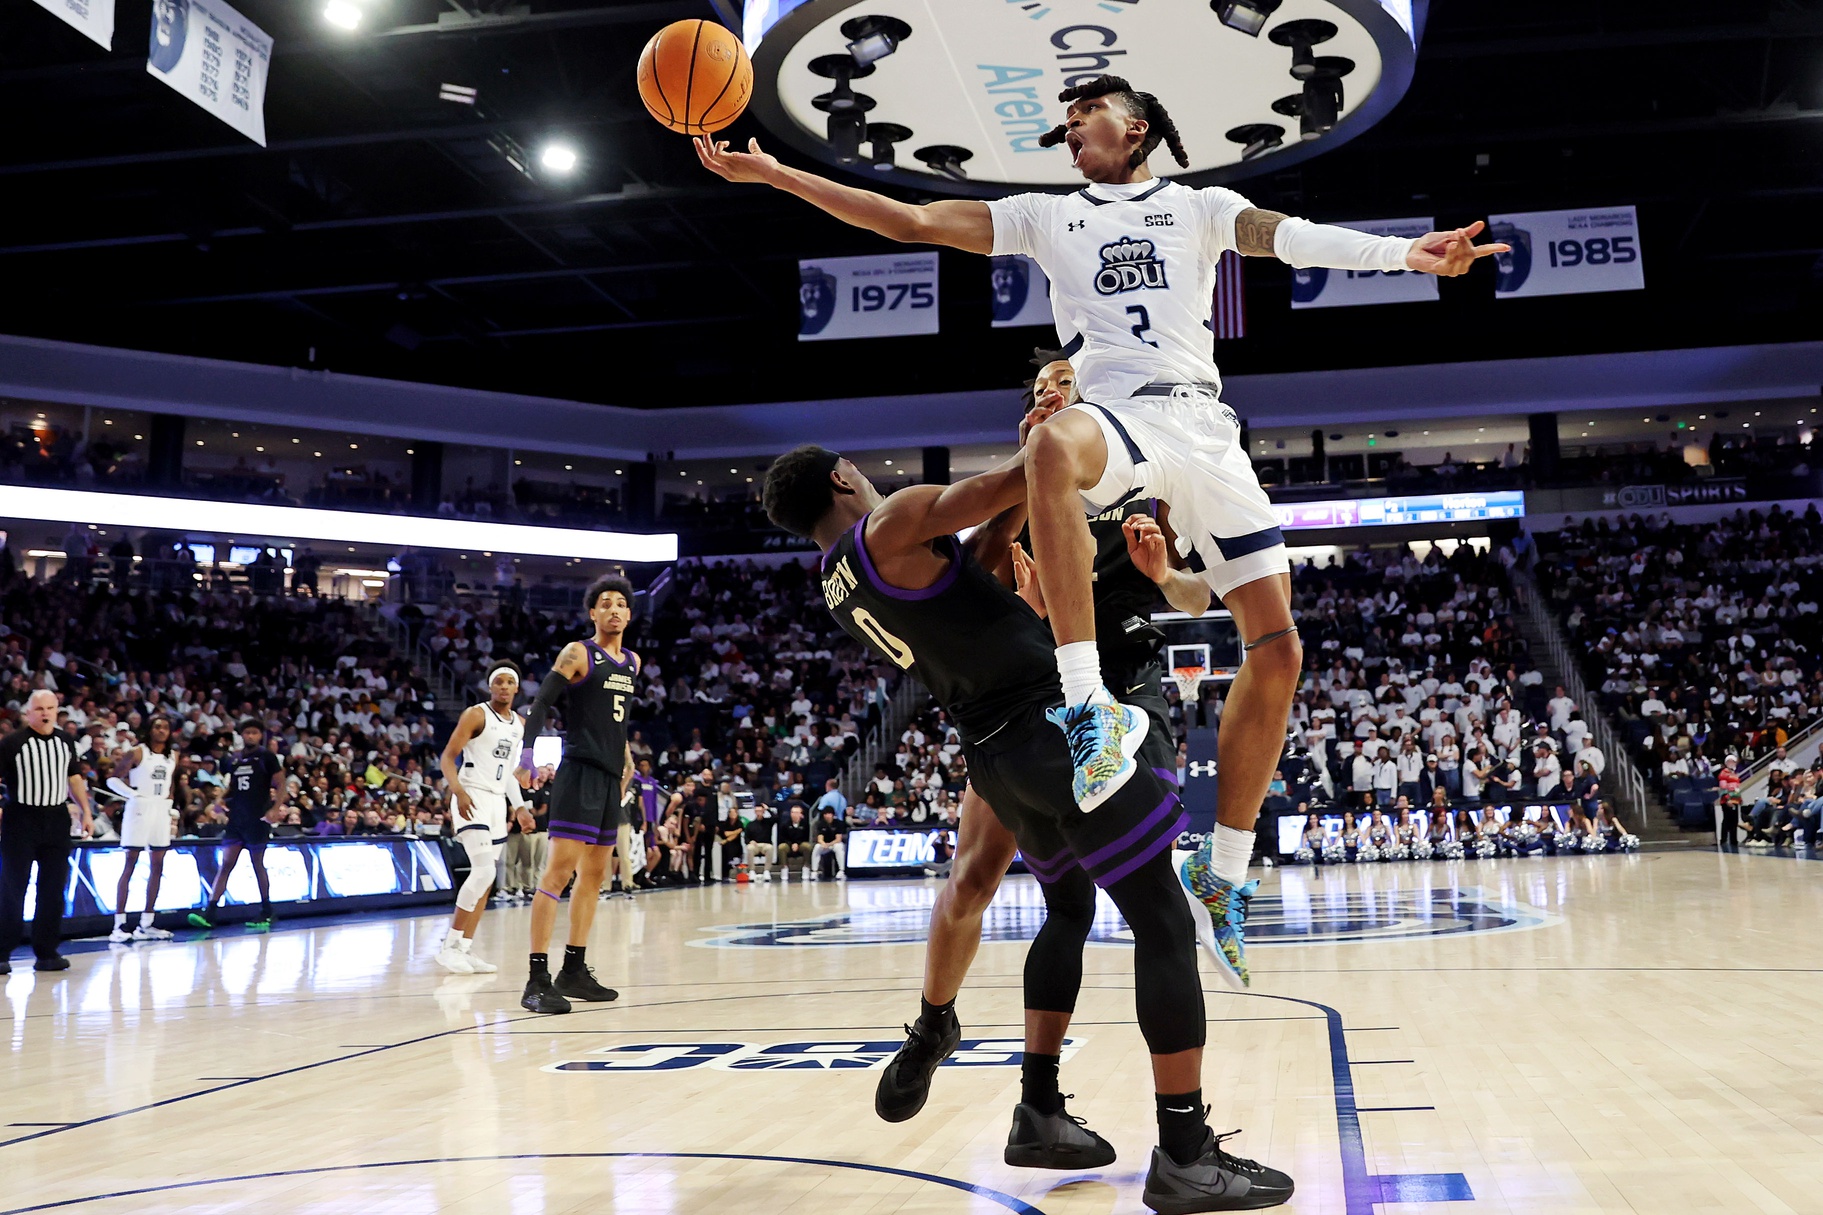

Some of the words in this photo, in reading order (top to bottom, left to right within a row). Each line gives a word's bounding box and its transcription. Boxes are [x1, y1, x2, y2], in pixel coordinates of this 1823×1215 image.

[976, 64, 1057, 153] Arena
[1548, 236, 1636, 269] 1985
[1094, 260, 1170, 295] ODU
[852, 282, 933, 312] 1975
[1125, 304, 1159, 348] 2
[1667, 485, 1746, 504] SPORTS
[850, 606, 915, 670] 0
[612, 694, 625, 722] 5
[237, 775, 251, 791] 15
[495, 764, 504, 781] 0
[857, 833, 936, 862] TEAM
